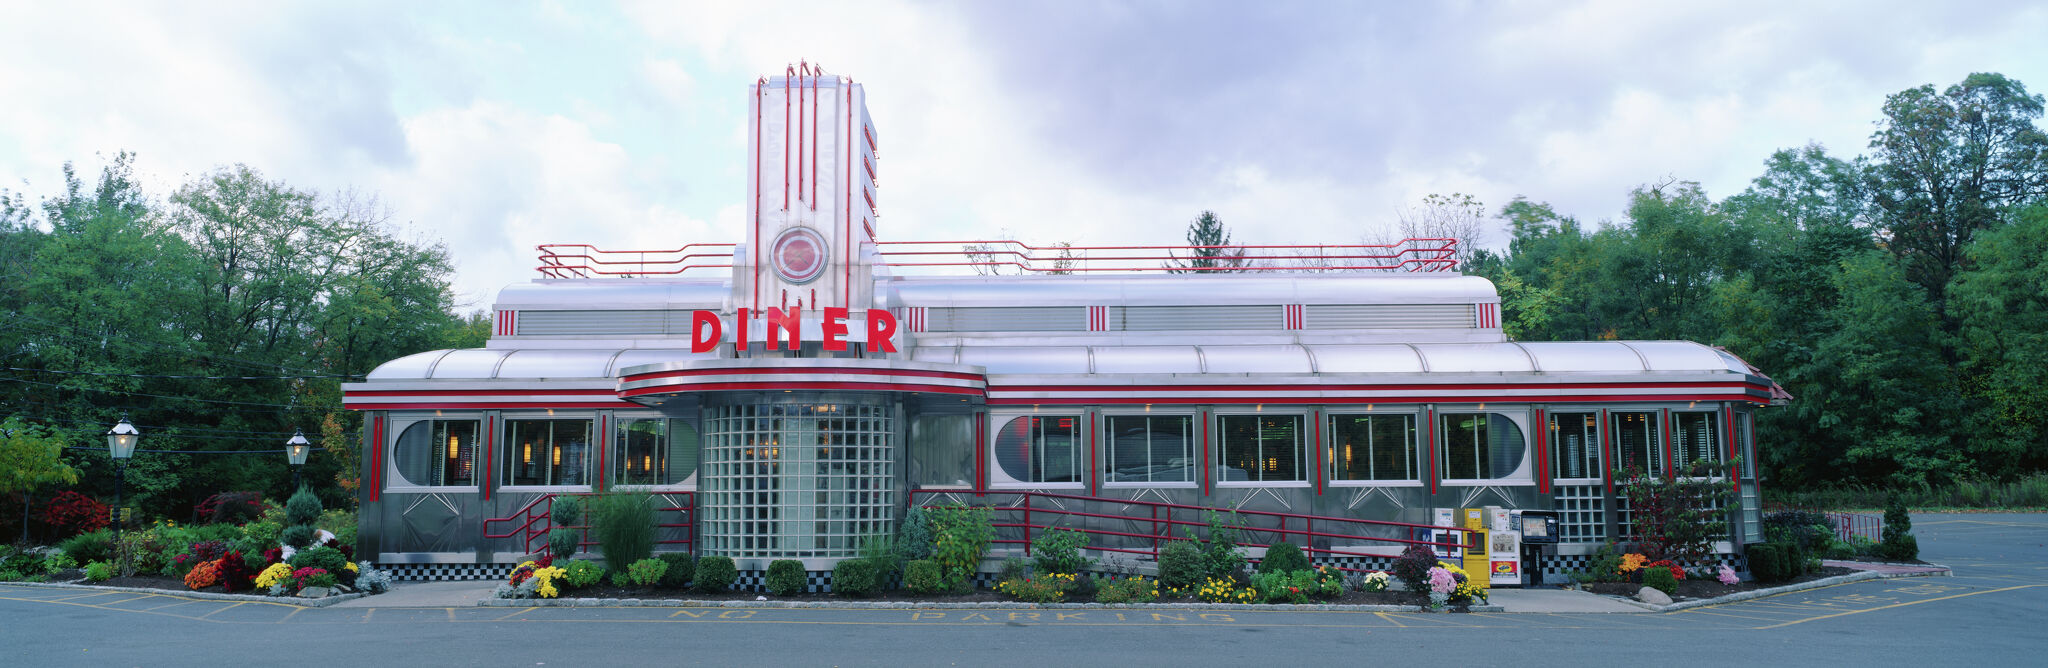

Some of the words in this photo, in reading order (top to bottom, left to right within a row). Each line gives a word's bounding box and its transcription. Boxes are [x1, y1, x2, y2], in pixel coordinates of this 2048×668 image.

[691, 306, 898, 353] DINER
[668, 610, 758, 619] NO
[911, 612, 1236, 622] PARKING
